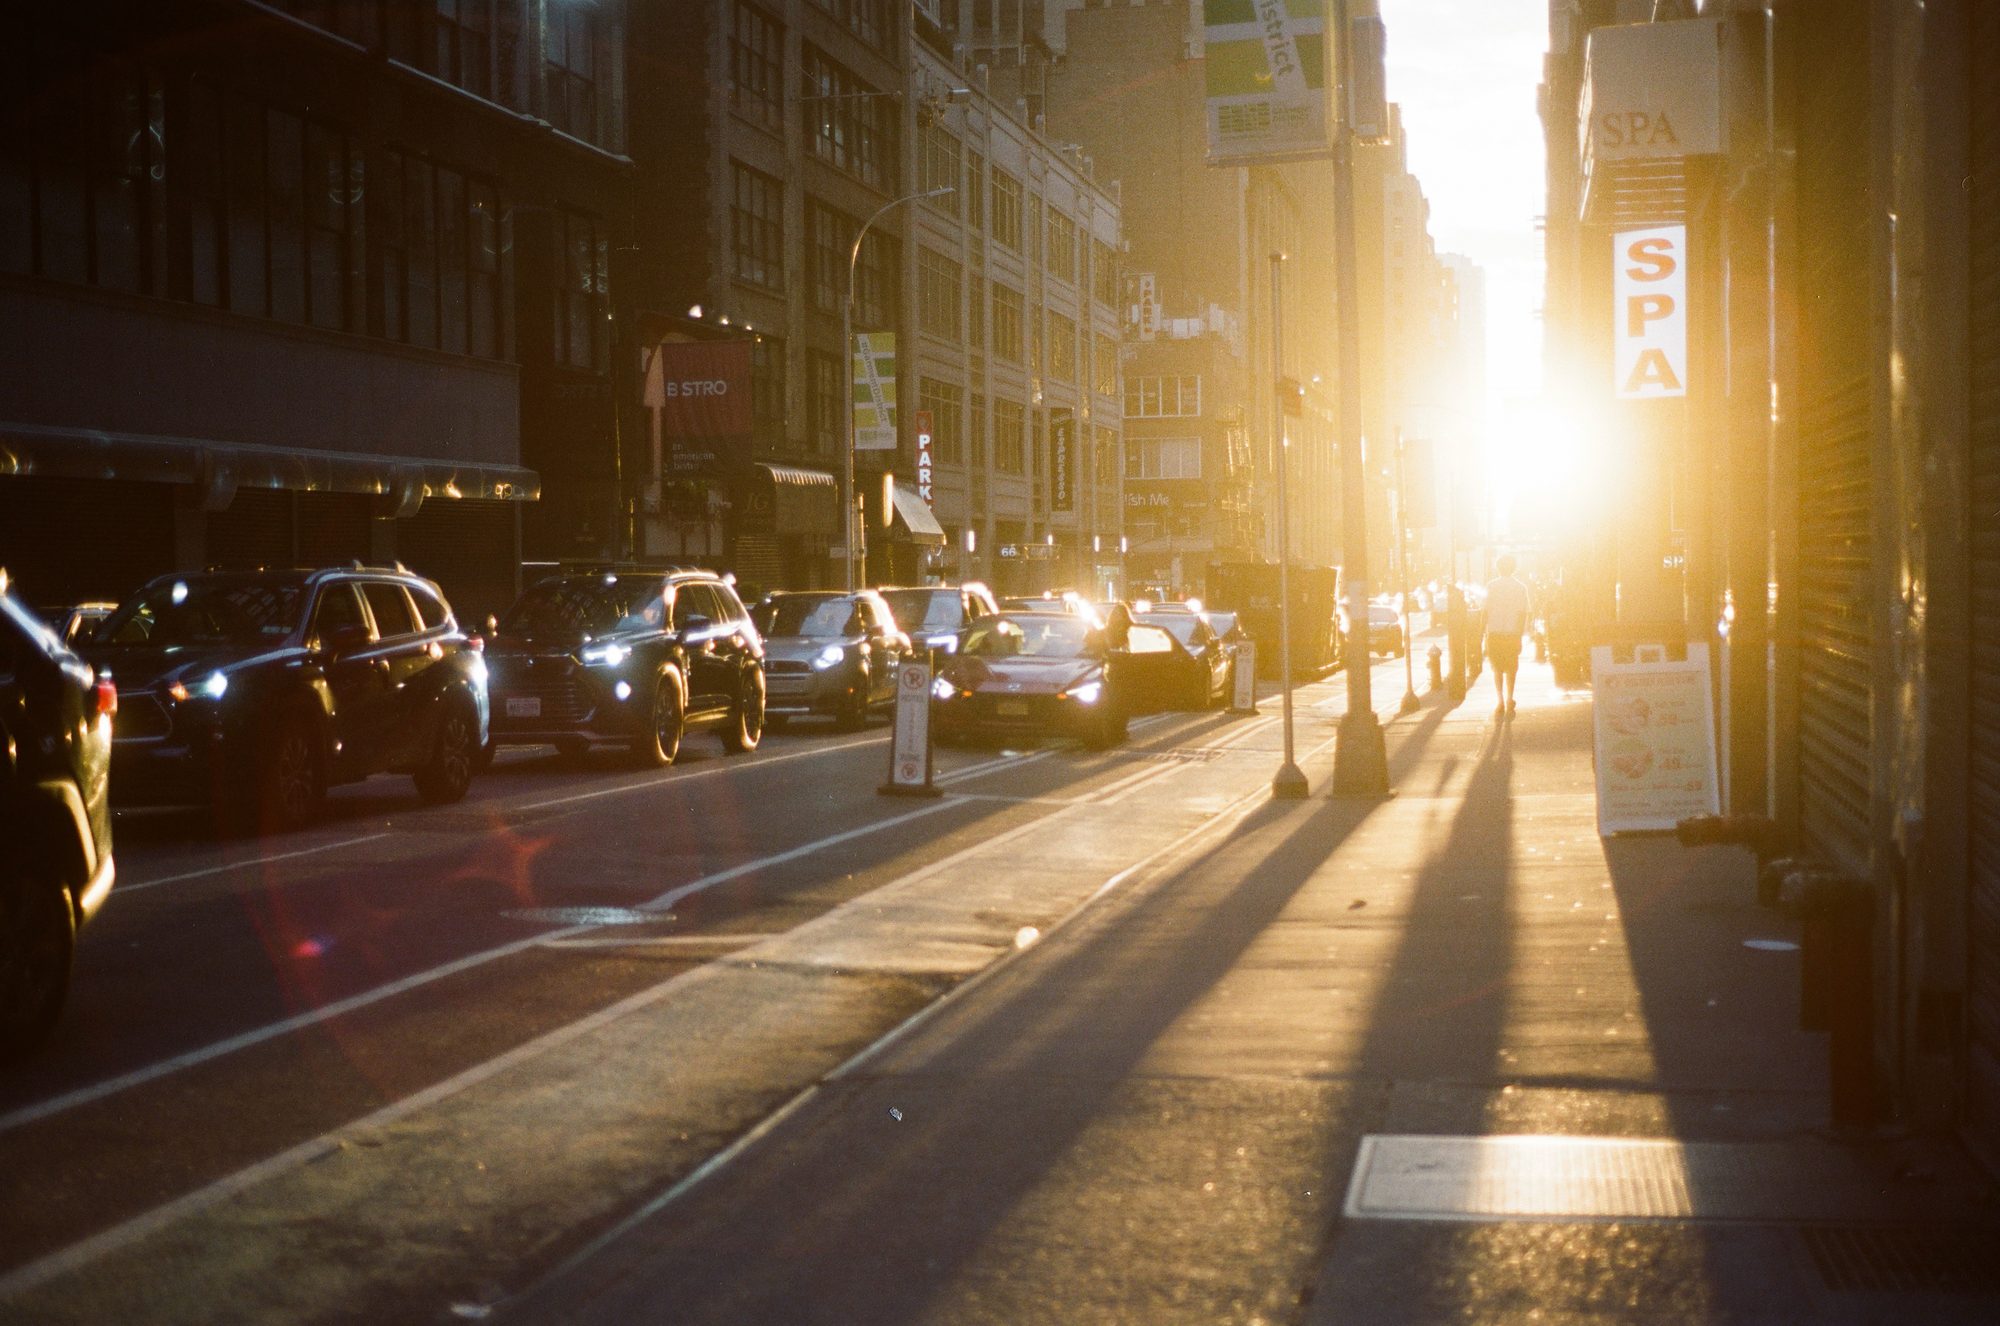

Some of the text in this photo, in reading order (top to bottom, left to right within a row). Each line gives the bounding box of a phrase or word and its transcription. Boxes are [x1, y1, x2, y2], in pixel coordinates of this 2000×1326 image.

[1602, 111, 1677, 148] SPA
[1624, 237, 1682, 393] SPA
[666, 380, 728, 397] BSTRO
[918, 434, 933, 511] PARK
[1001, 547, 1017, 557] 66
